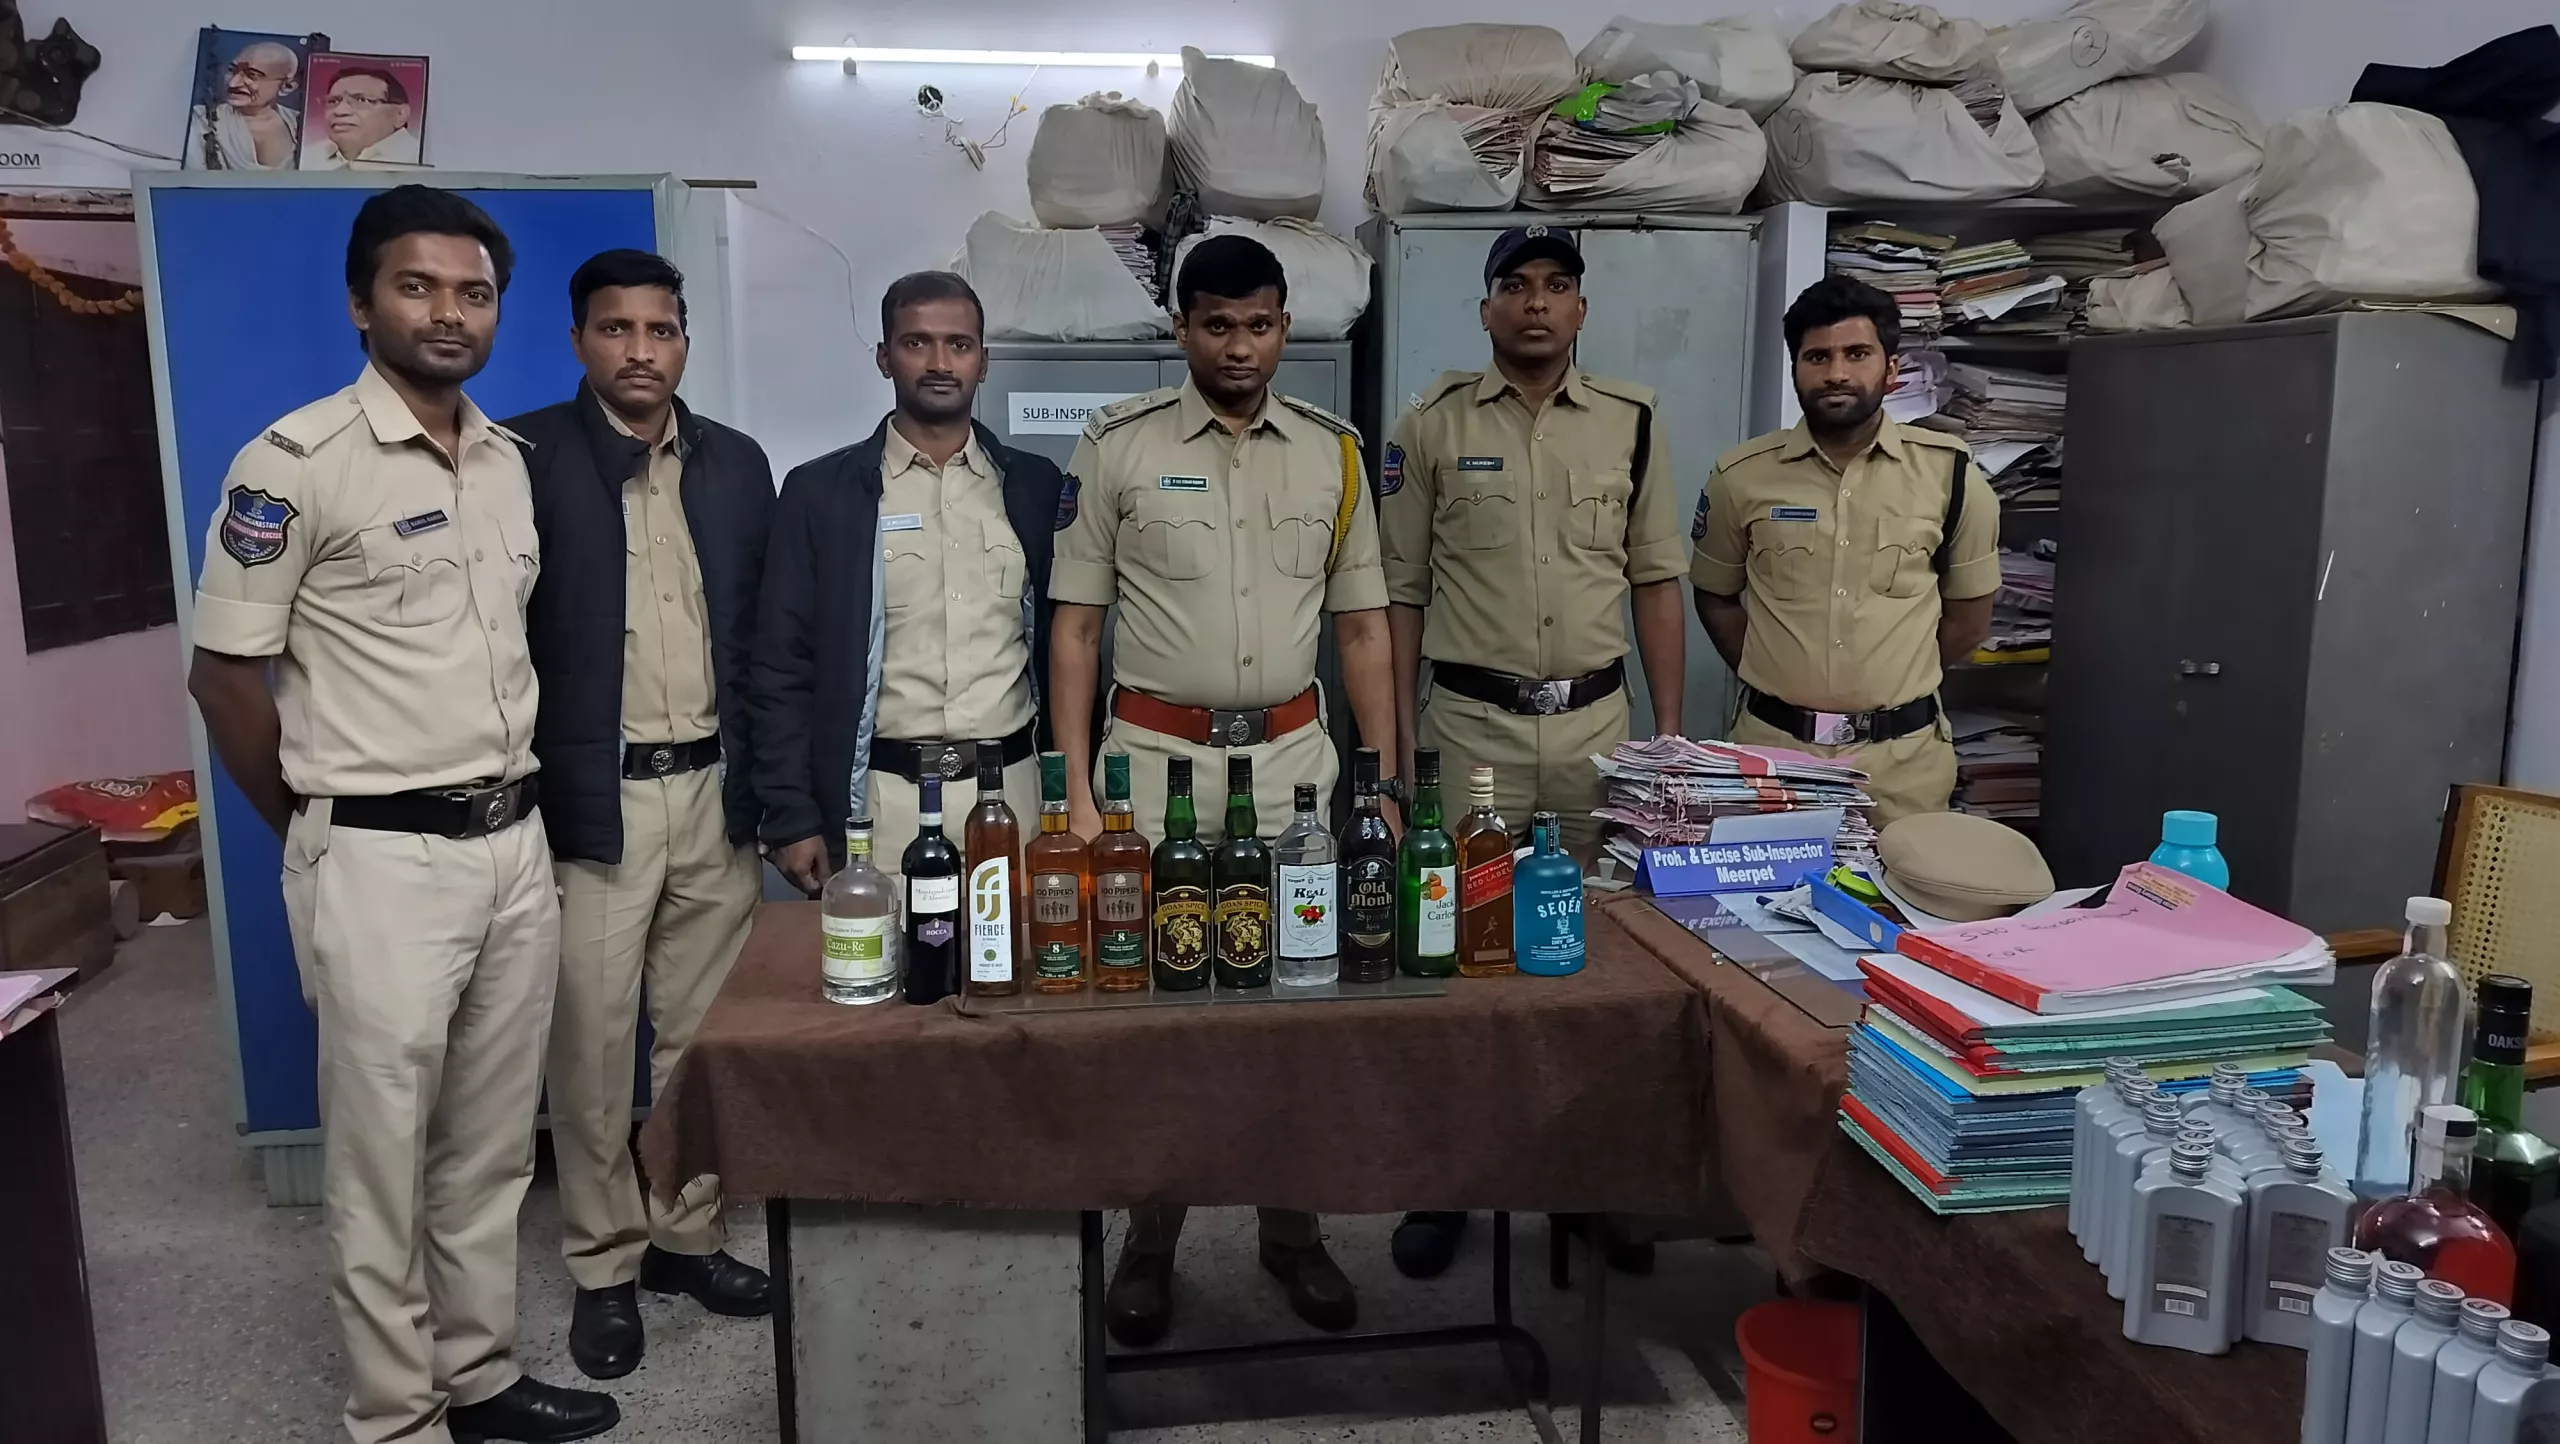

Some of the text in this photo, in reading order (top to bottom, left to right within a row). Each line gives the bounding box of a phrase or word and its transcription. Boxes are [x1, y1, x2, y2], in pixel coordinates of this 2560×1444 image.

[1652, 842, 1824, 868] Proh. & Excise Sub-Inspector
[1466, 867, 1512, 890] RED LABEL
[1715, 864, 1776, 885] Meerpet
[1048, 887, 1074, 897] PIPERS
[1114, 886, 1140, 896] PIPERS
[1358, 881, 1386, 894] Old
[1220, 900, 1265, 909] GOAN SPICE
[1351, 892, 1393, 907] Monk
[1161, 902, 1206, 913] GOAN SPICE
[926, 928, 948, 936] ROCCA
[974, 923, 1006, 937] FIERCE
[1115, 932, 1126, 942] 8
[826, 937, 865, 952] Cazu-Re
[1052, 944, 1060, 954] 8
